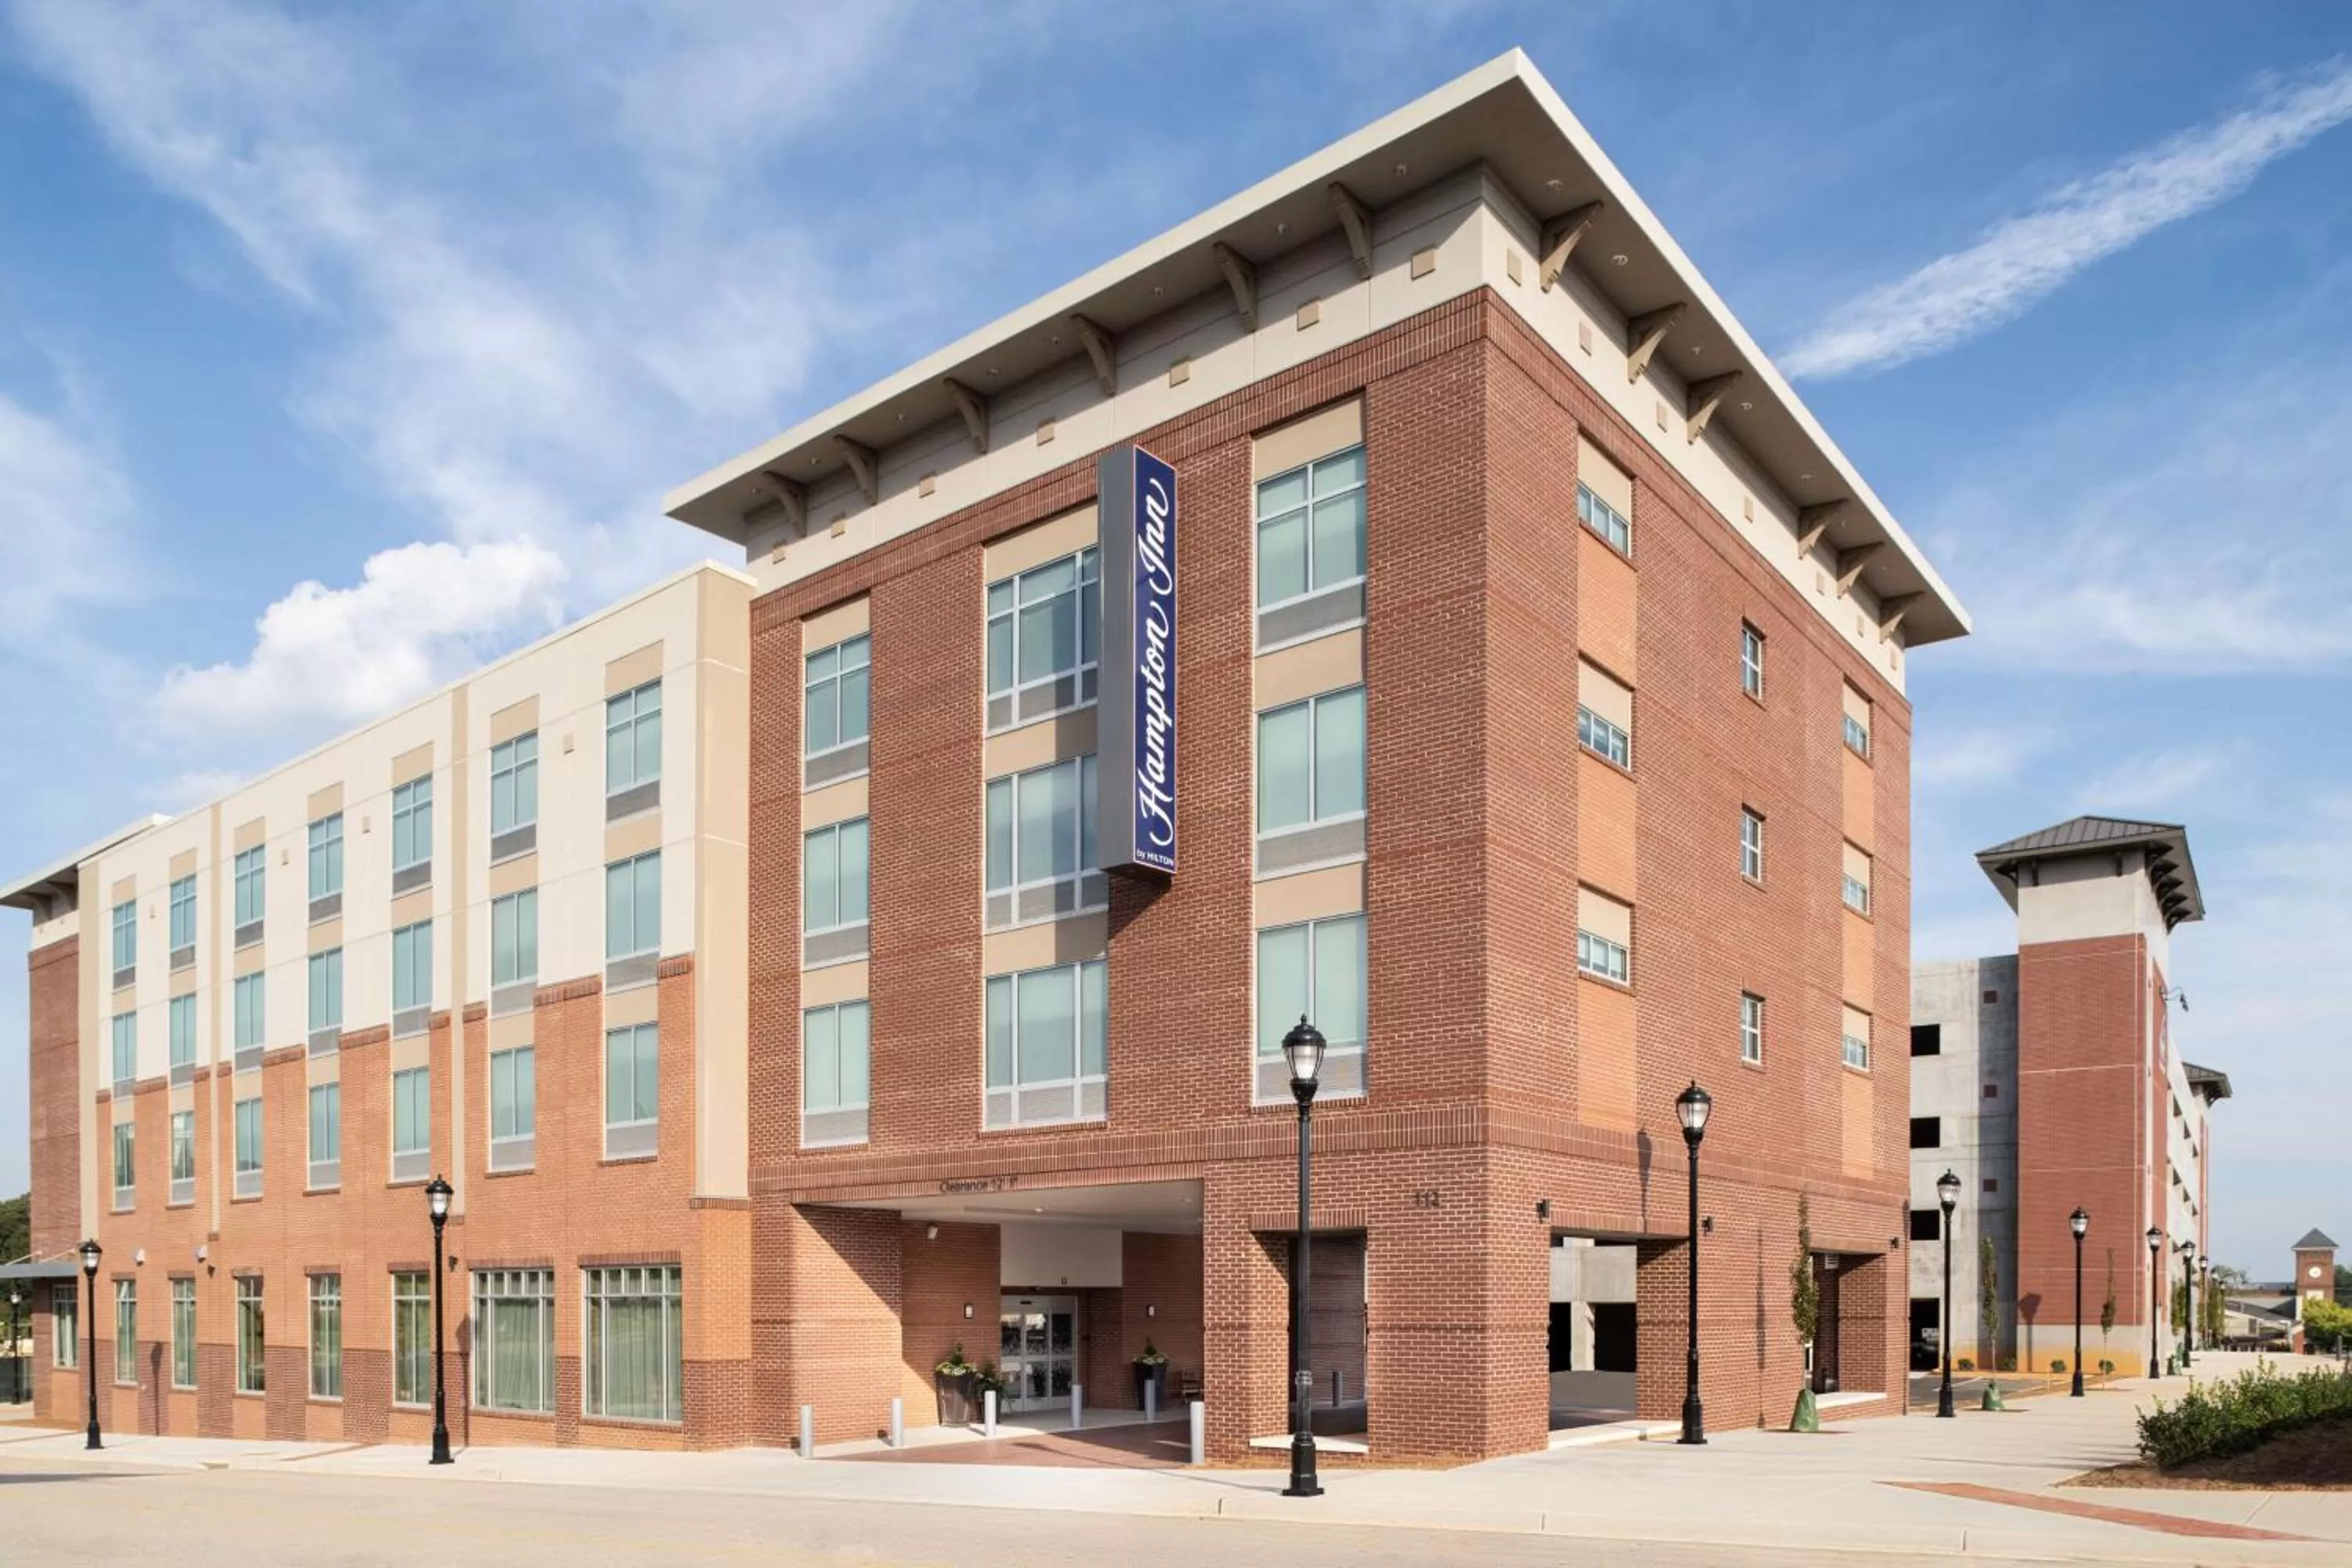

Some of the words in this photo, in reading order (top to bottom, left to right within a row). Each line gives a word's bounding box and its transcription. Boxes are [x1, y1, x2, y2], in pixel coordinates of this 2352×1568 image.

[1138, 477, 1173, 596] Inn
[1138, 601, 1174, 846] Hampton
[1136, 849, 1145, 860] by
[1147, 851, 1174, 866] HILTON
[939, 1179, 989, 1193] Clearance
